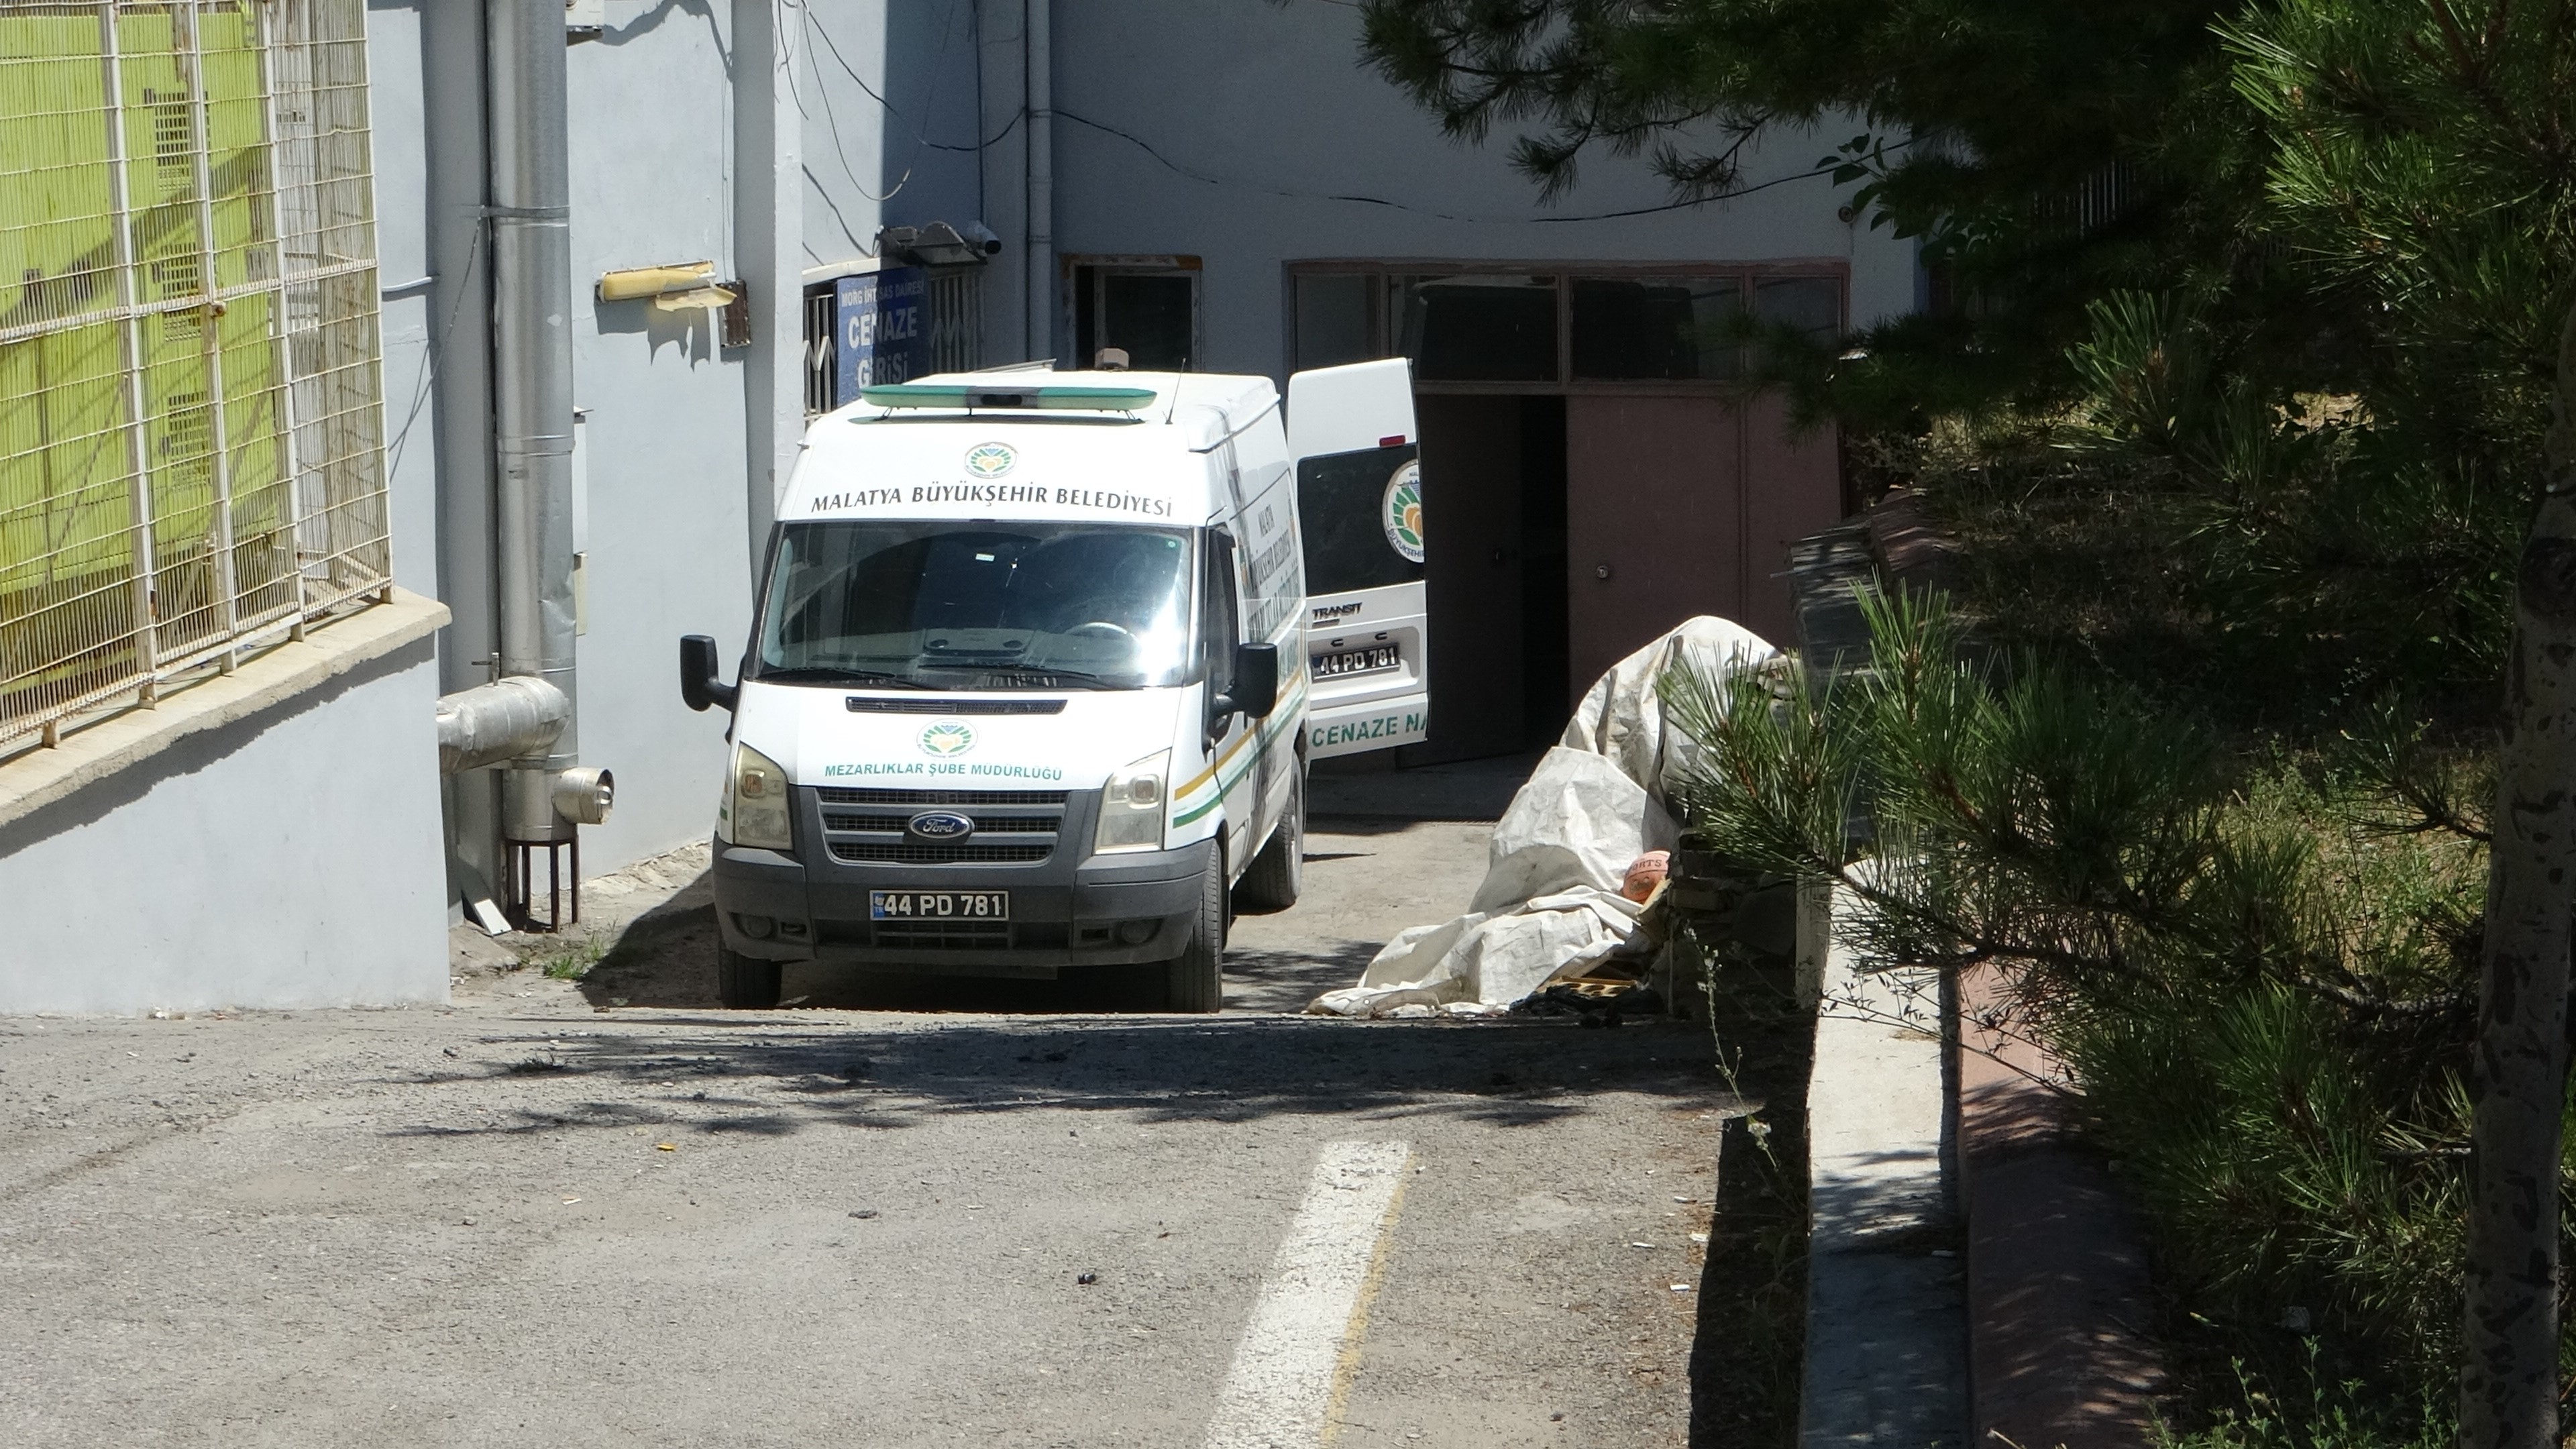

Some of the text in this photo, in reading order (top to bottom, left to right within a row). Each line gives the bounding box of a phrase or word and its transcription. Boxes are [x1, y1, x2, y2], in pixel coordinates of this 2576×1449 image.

[841, 289, 863, 307] MORG
[848, 306, 918, 349] CENAZE
[810, 480, 1172, 517] MALATYA BÜYÜKŞEHİR BELEDİYESİ
[1312, 602, 1362, 619] TRANSIT
[1320, 654, 1340, 674] 44
[1343, 651, 1366, 672] PD
[1369, 647, 1395, 667] 781
[1312, 716, 1398, 748] CENAZE
[824, 762, 1063, 781] MEZARLIKLAR ŞUBE MÜDÜRLÜĞÜ
[923, 818, 956, 833] Ford
[884, 894, 1000, 916] 44 PD 781
